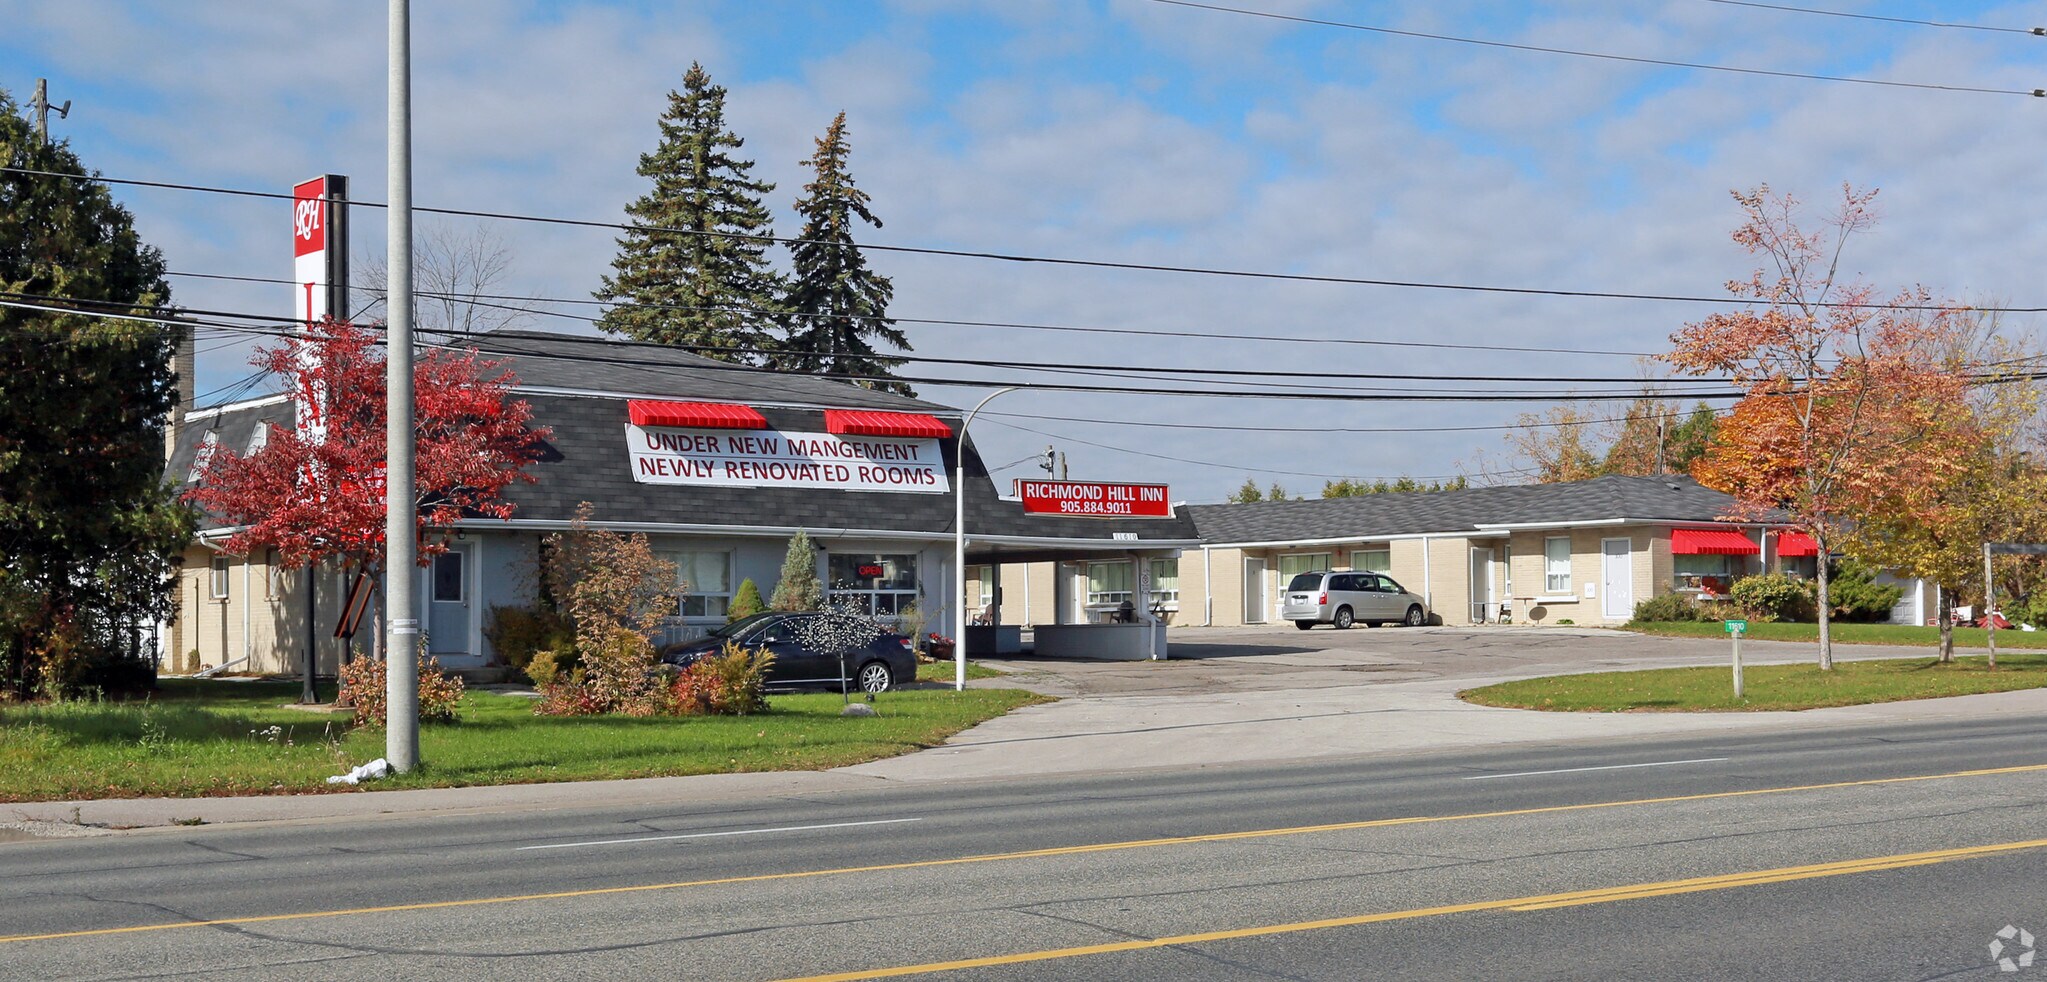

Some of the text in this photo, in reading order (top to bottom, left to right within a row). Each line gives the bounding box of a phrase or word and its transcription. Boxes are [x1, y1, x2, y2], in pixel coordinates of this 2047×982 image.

[646, 432, 918, 461] UNDER NEW MANGEMENT
[640, 457, 936, 485] NEWLY RENOVATED ROOMS
[1026, 483, 1163, 502] RICHMOND HILL INN
[1060, 500, 1132, 514] 905.884.9011
[859, 565, 882, 575] OPEN
